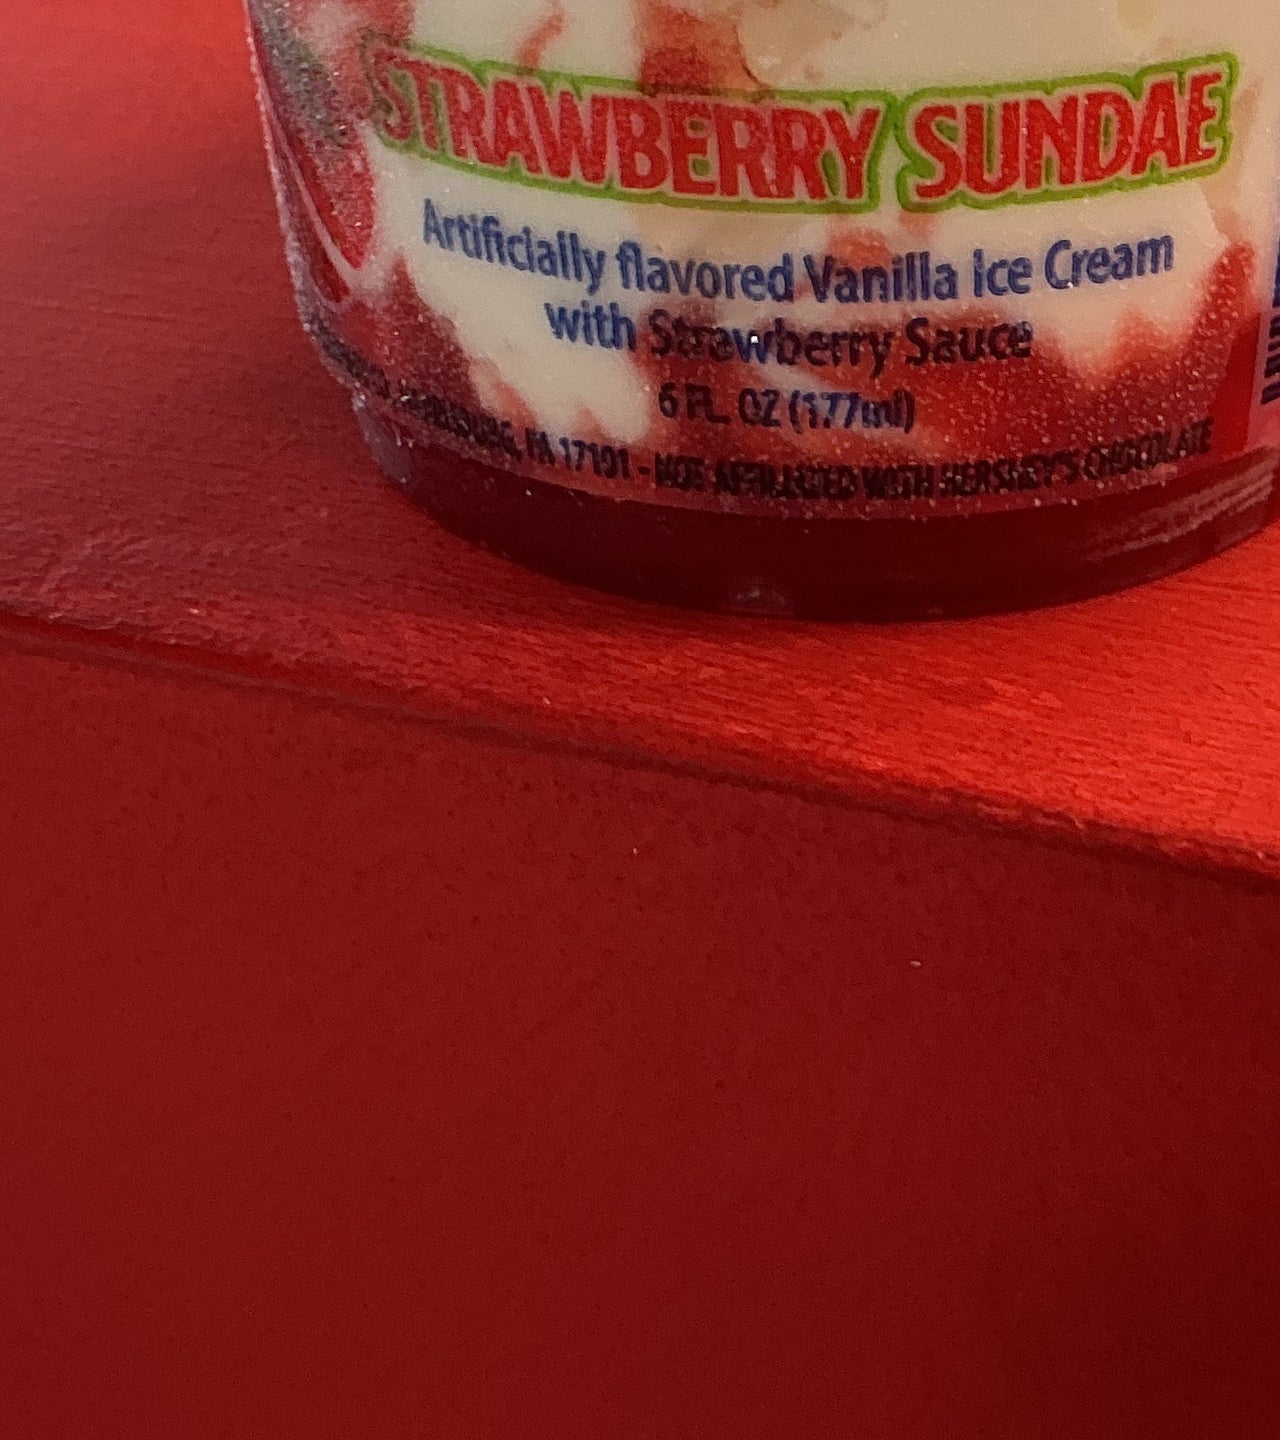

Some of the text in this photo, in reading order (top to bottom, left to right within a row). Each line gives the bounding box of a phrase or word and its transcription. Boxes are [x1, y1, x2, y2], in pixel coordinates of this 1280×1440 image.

[370, 45, 1223, 202] STRAWBERRY SUNDAE
[422, 197, 607, 295] Artificially
[615, 239, 795, 303] flavored
[803, 250, 958, 304] Vanilla
[1044, 234, 1175, 291] Cream
[543, 298, 1035, 378] with Strawberry Sauce
[658, 382, 679, 418] 6
[737, 387, 781, 428] OZ
